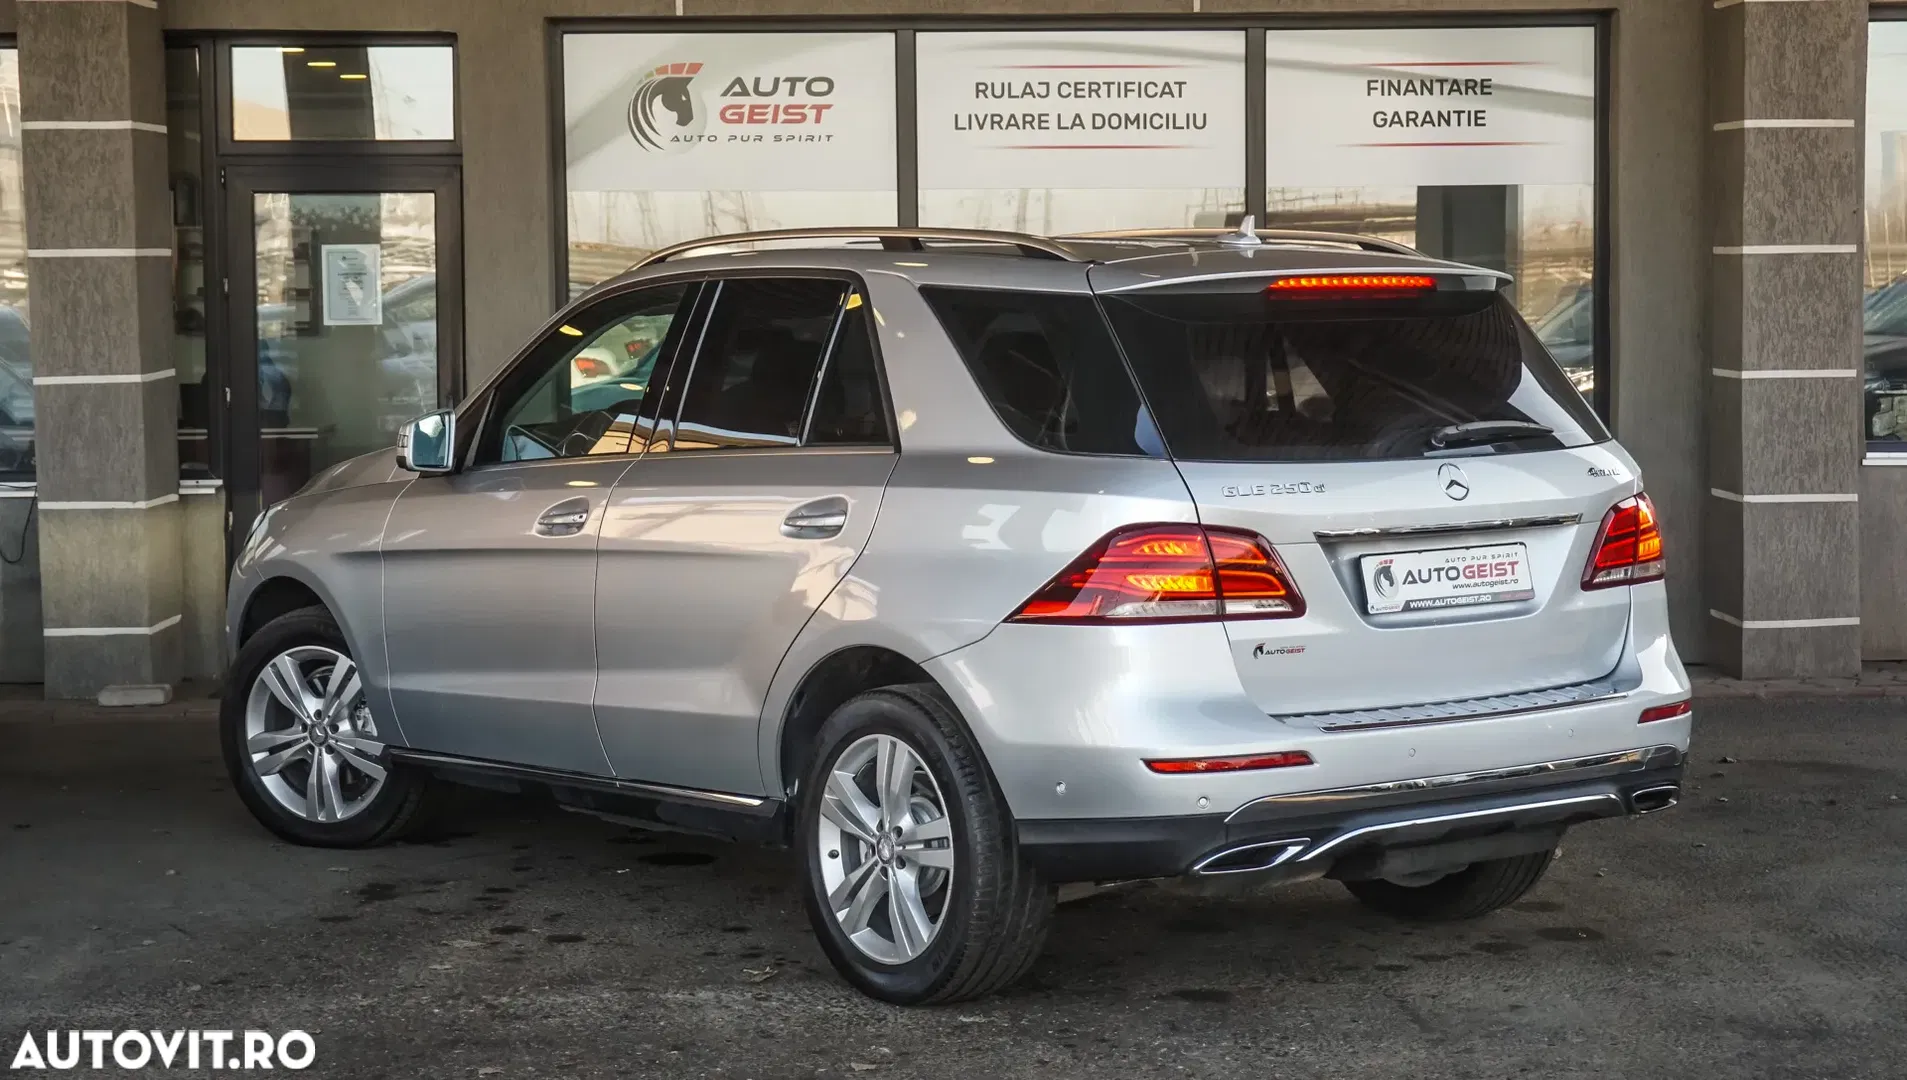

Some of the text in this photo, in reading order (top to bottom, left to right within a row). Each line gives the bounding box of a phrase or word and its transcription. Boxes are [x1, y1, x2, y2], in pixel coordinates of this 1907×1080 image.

[720, 76, 835, 97] AUTO
[975, 81, 1187, 99] RULAJ CERTIFICAT
[1366, 78, 1493, 97] FINANTARE
[719, 103, 834, 124] GEIST
[954, 112, 1207, 131] LIVRARE LA DOMICILIU
[1372, 109, 1487, 128] GARANTIE
[670, 134, 834, 142] AUTO PUR SPIRIT
[1221, 485, 1265, 497] GLE
[1491, 551, 1518, 560] SPIRIT
[1452, 578, 1519, 590] www.autogeist.ro
[1409, 594, 1492, 609] WWW.AUTOGEIST.RO
